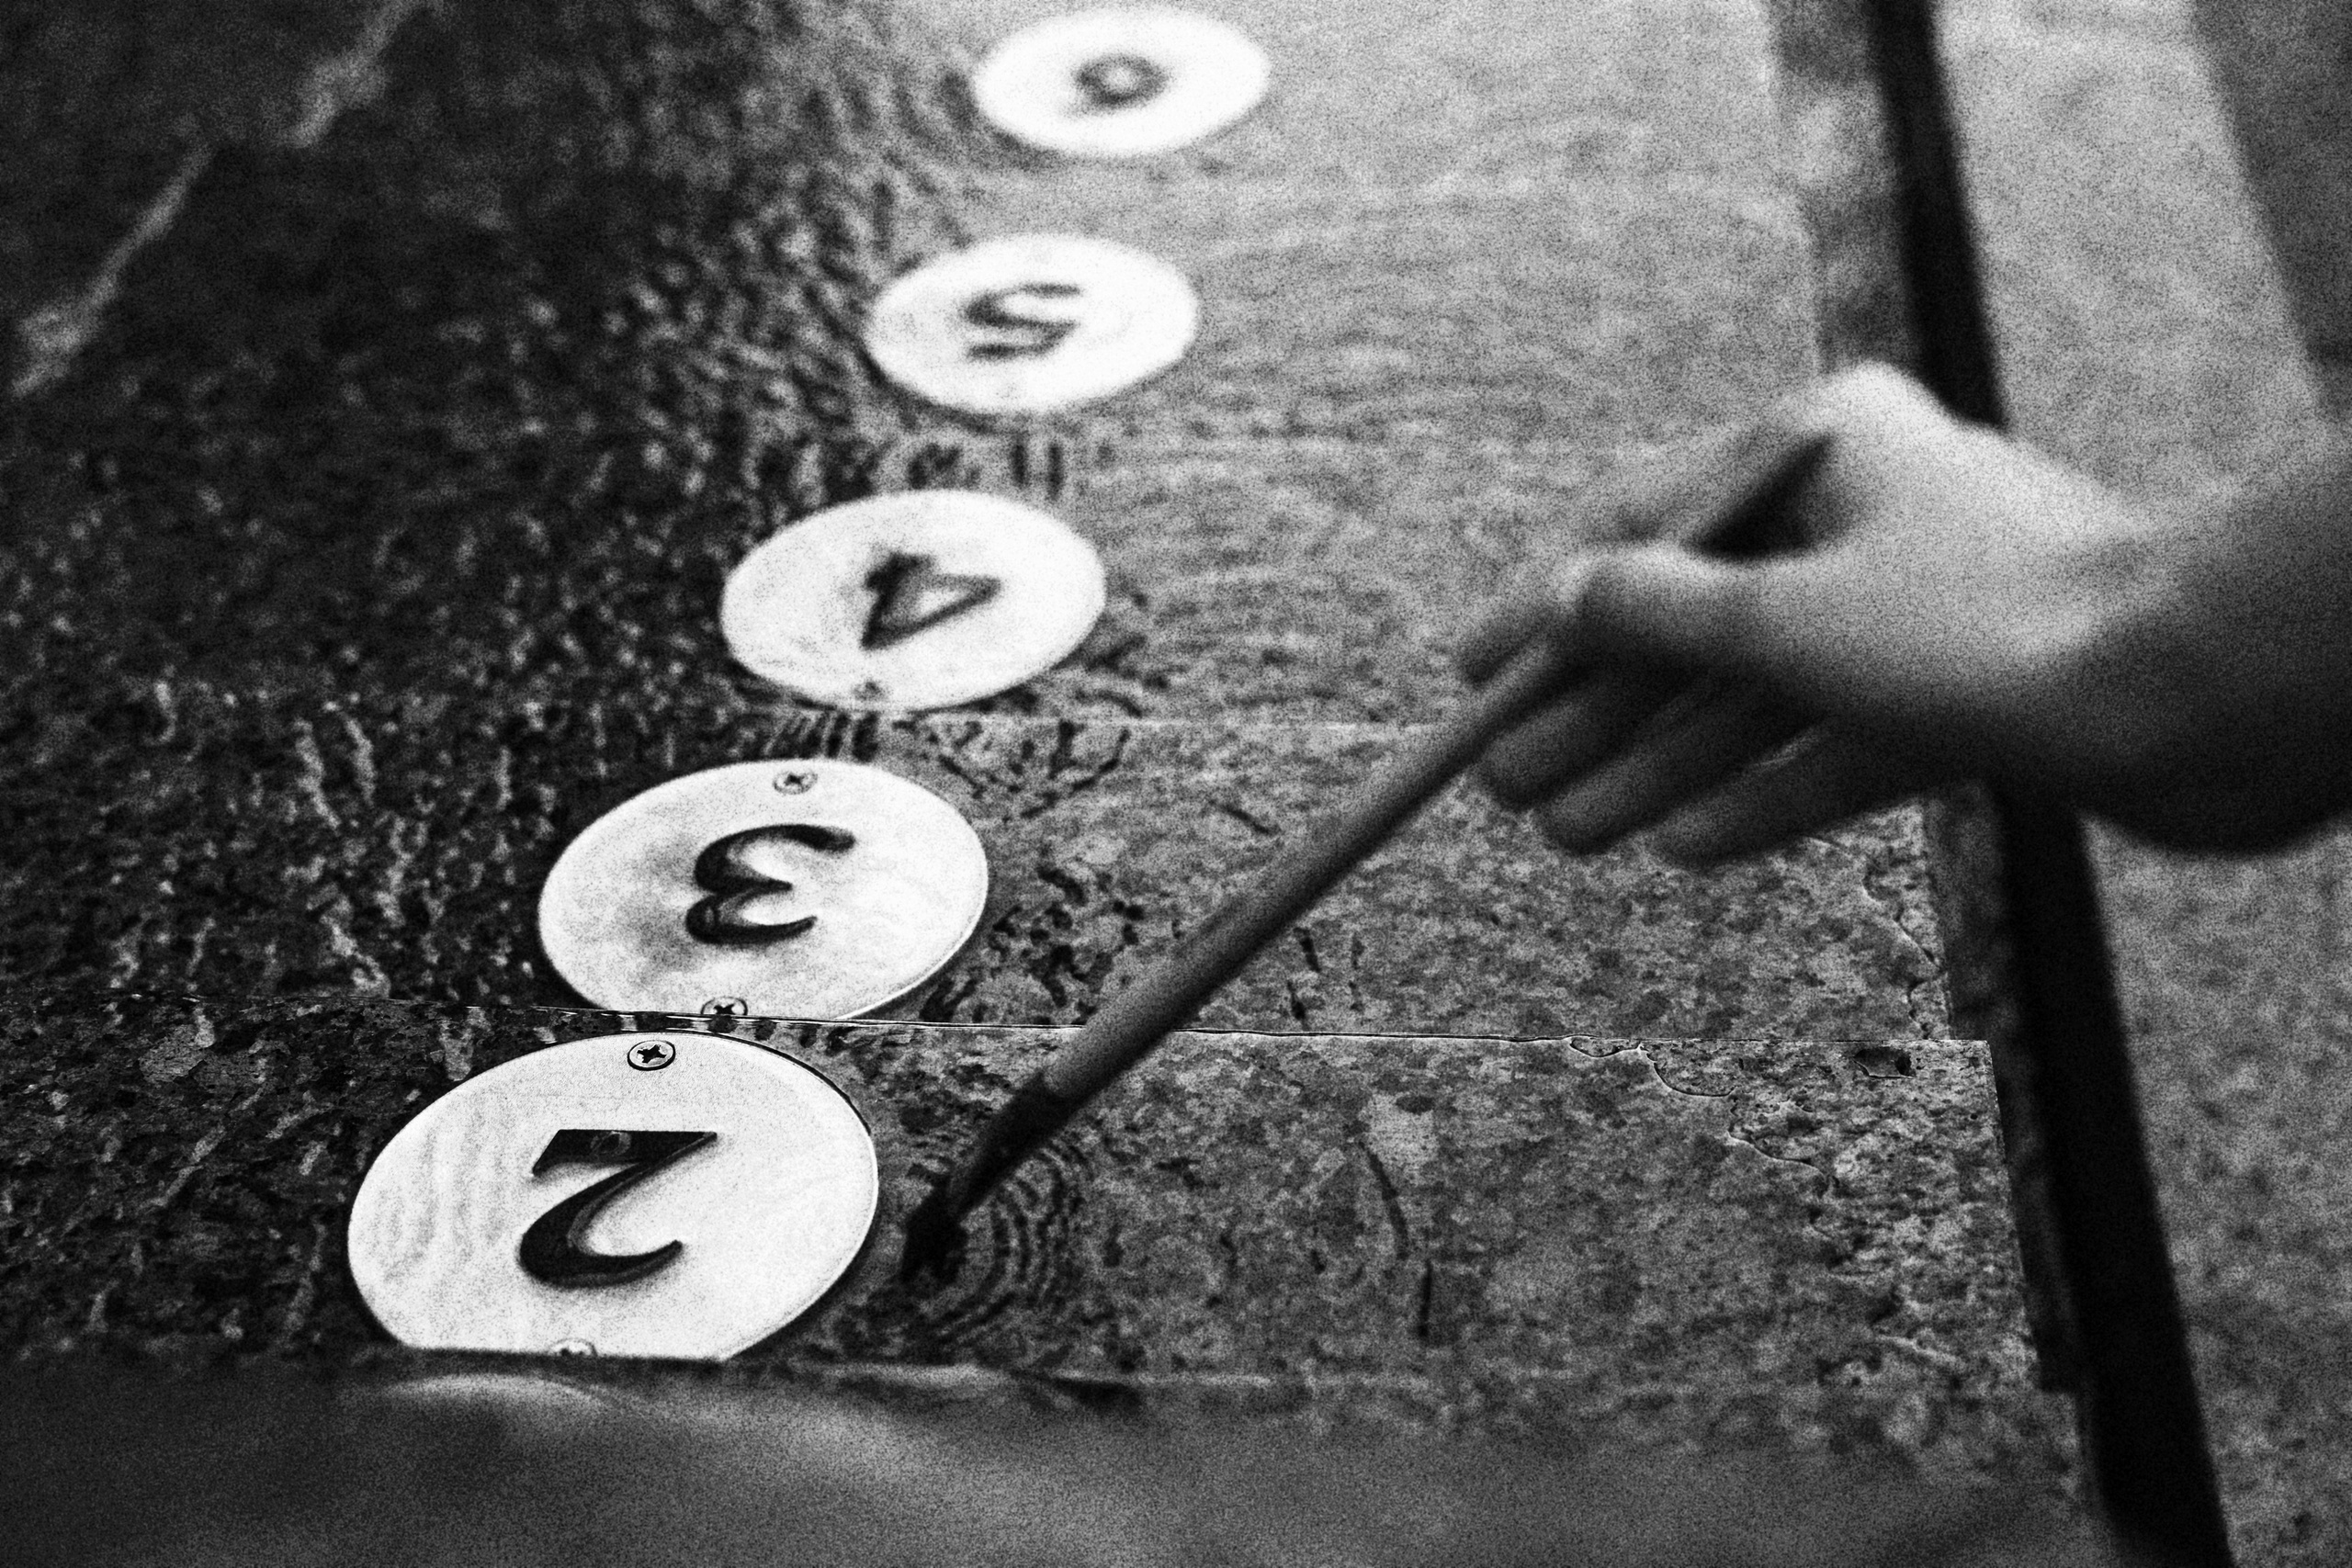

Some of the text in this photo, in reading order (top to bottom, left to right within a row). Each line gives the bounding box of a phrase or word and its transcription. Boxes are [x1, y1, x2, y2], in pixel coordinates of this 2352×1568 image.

[960, 281, 1082, 362] 5
[861, 552, 1001, 650] 4
[684, 823, 856, 946] 3
[518, 1129, 718, 1288] 2
